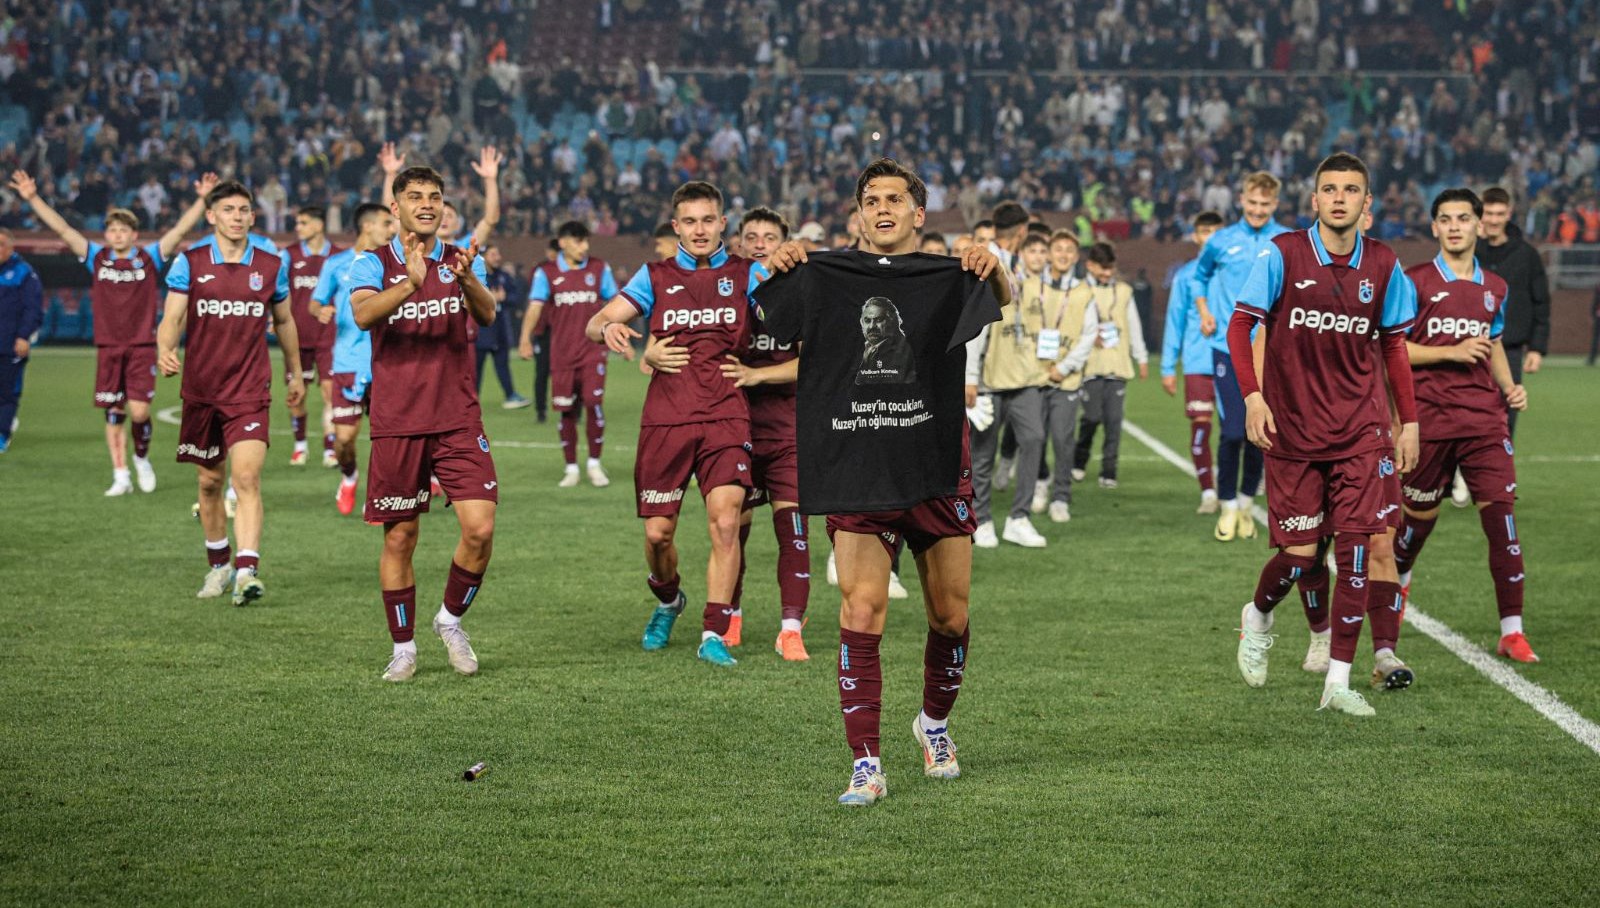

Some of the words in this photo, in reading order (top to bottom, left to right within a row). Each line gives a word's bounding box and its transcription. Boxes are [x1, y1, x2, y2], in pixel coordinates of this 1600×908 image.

[98, 266, 145, 284] papara
[293, 275, 319, 290] pap
[554, 290, 598, 307] papara
[196, 298, 265, 319] papara
[388, 296, 460, 325] papara
[663, 307, 737, 331] papara
[1289, 307, 1370, 335] papara
[1427, 317, 1491, 339] papara
[851, 399, 887, 414] Kuzey'in
[832, 416, 867, 432] Kuzey'in
[868, 414, 898, 430] oğlunu
